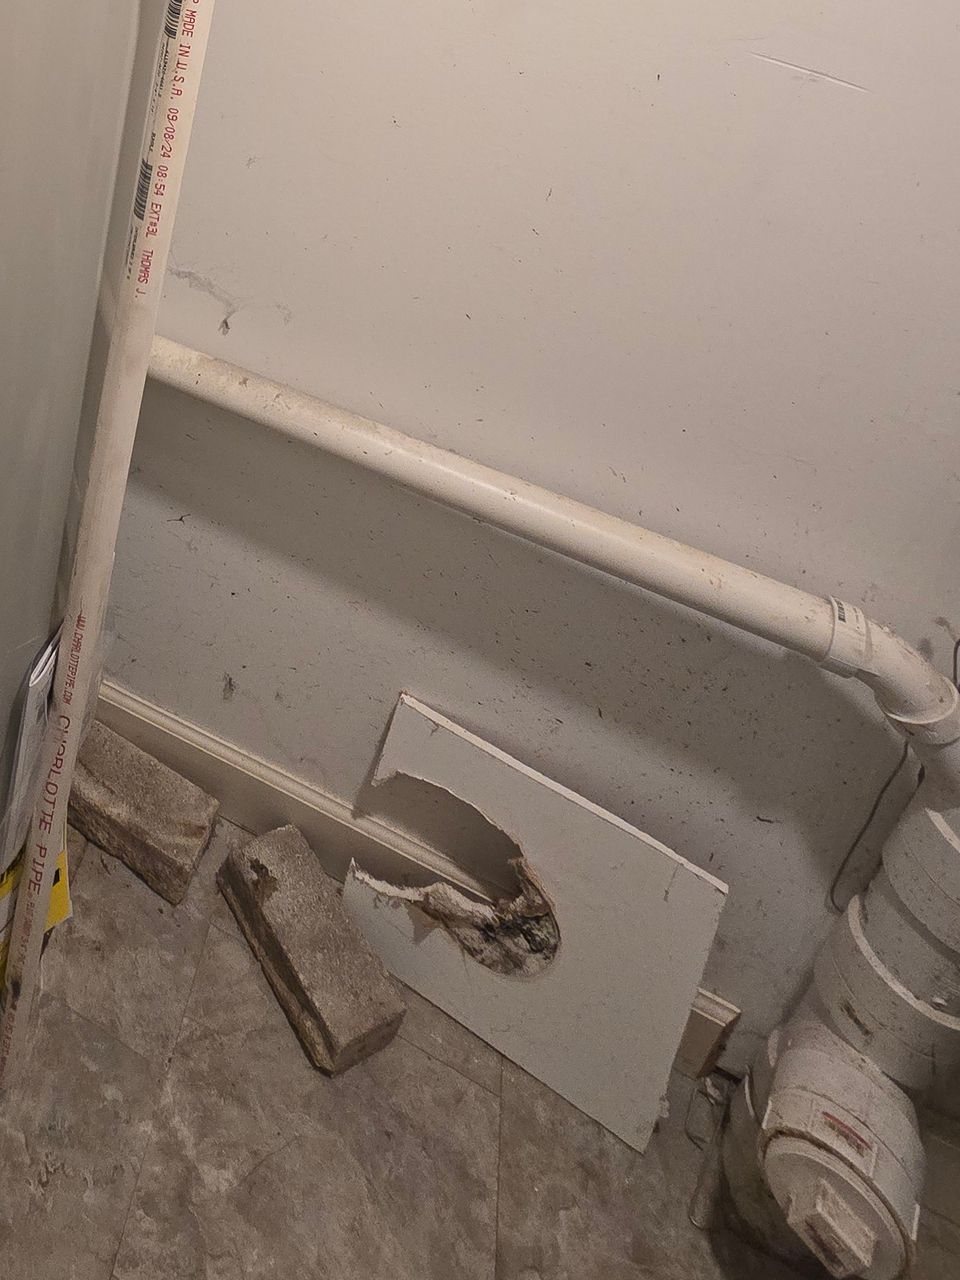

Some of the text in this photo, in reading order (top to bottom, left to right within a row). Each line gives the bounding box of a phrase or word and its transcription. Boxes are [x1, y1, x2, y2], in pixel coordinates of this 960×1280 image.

[181, 9, 198, 38] MADE
[178, 44, 191, 58] IN
[170, 60, 188, 100] U.S.A.
[160, 108, 180, 159] 09/08/24
[153, 164, 169, 197] 08:54
[138, 249, 154, 284] THOMAS
[28, 843, 48, 895] PIPE
